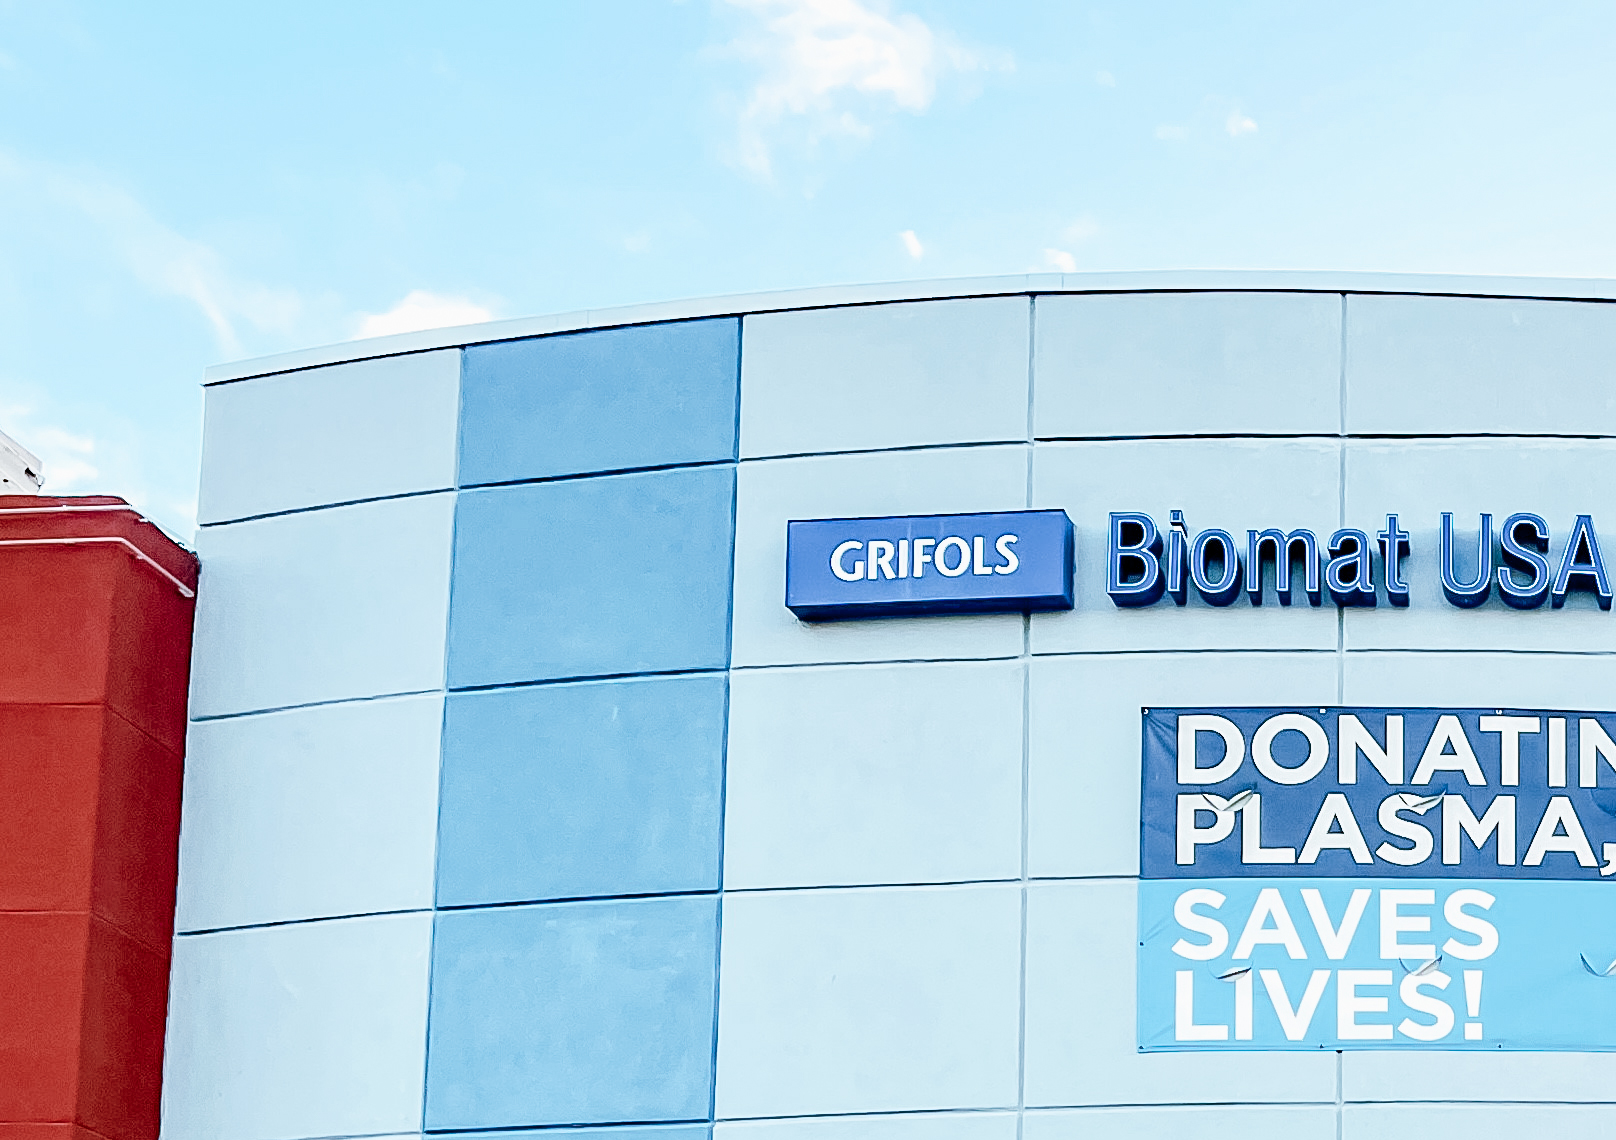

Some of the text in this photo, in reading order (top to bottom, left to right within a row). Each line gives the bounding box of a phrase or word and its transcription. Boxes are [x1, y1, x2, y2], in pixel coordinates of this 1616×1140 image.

[830, 533, 1020, 582] GRIFOLS
[1106, 509, 1411, 603] Biomat
[1439, 511, 1614, 605] USA
[1171, 888, 1499, 961] SAVES
[1175, 969, 1483, 1041] LIVES!
